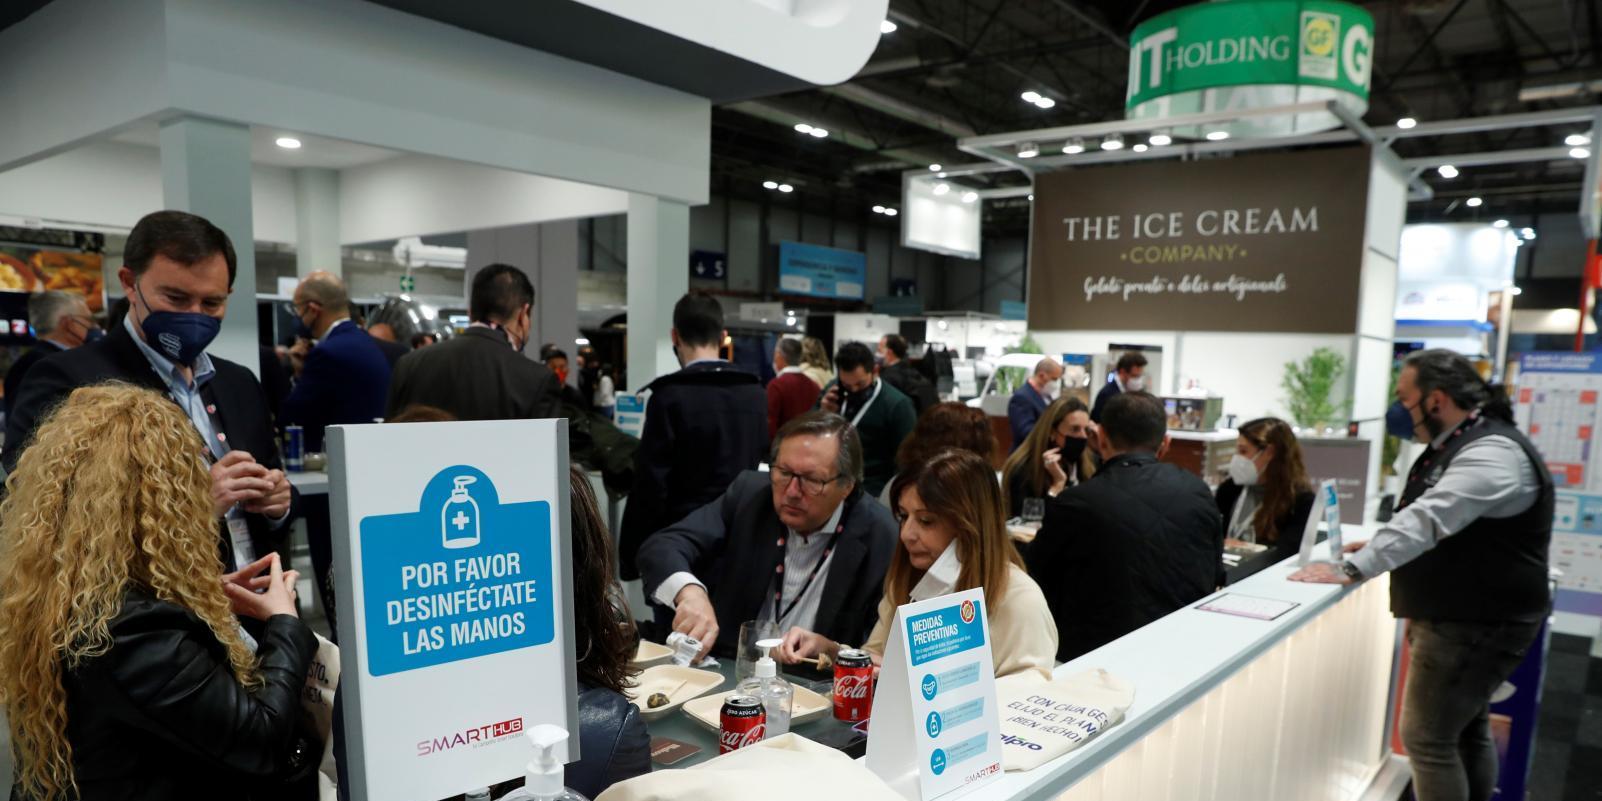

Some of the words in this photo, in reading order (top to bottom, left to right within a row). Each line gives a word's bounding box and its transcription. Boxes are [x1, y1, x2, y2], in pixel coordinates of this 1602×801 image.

[1166, 36, 1290, 71] HOLDING
[1063, 215, 1120, 241] THE
[1132, 212, 1183, 239] ICE
[1196, 206, 1319, 237] CREAM
[1130, 245, 1238, 264] COMPANY
[714, 261, 724, 278] 5
[401, 562, 448, 590] POR
[454, 552, 521, 583] FAVOR
[386, 580, 537, 626] DESINFÉCTATE
[402, 625, 445, 655] LAS
[451, 611, 526, 646] MANOS
[911, 615, 943, 633] MEDIDAS
[913, 623, 959, 646] PREVENTIVAS
[1007, 701, 1045, 716] ELIJO
[1042, 713, 1058, 722] EL
[1026, 695, 1056, 708] CON
